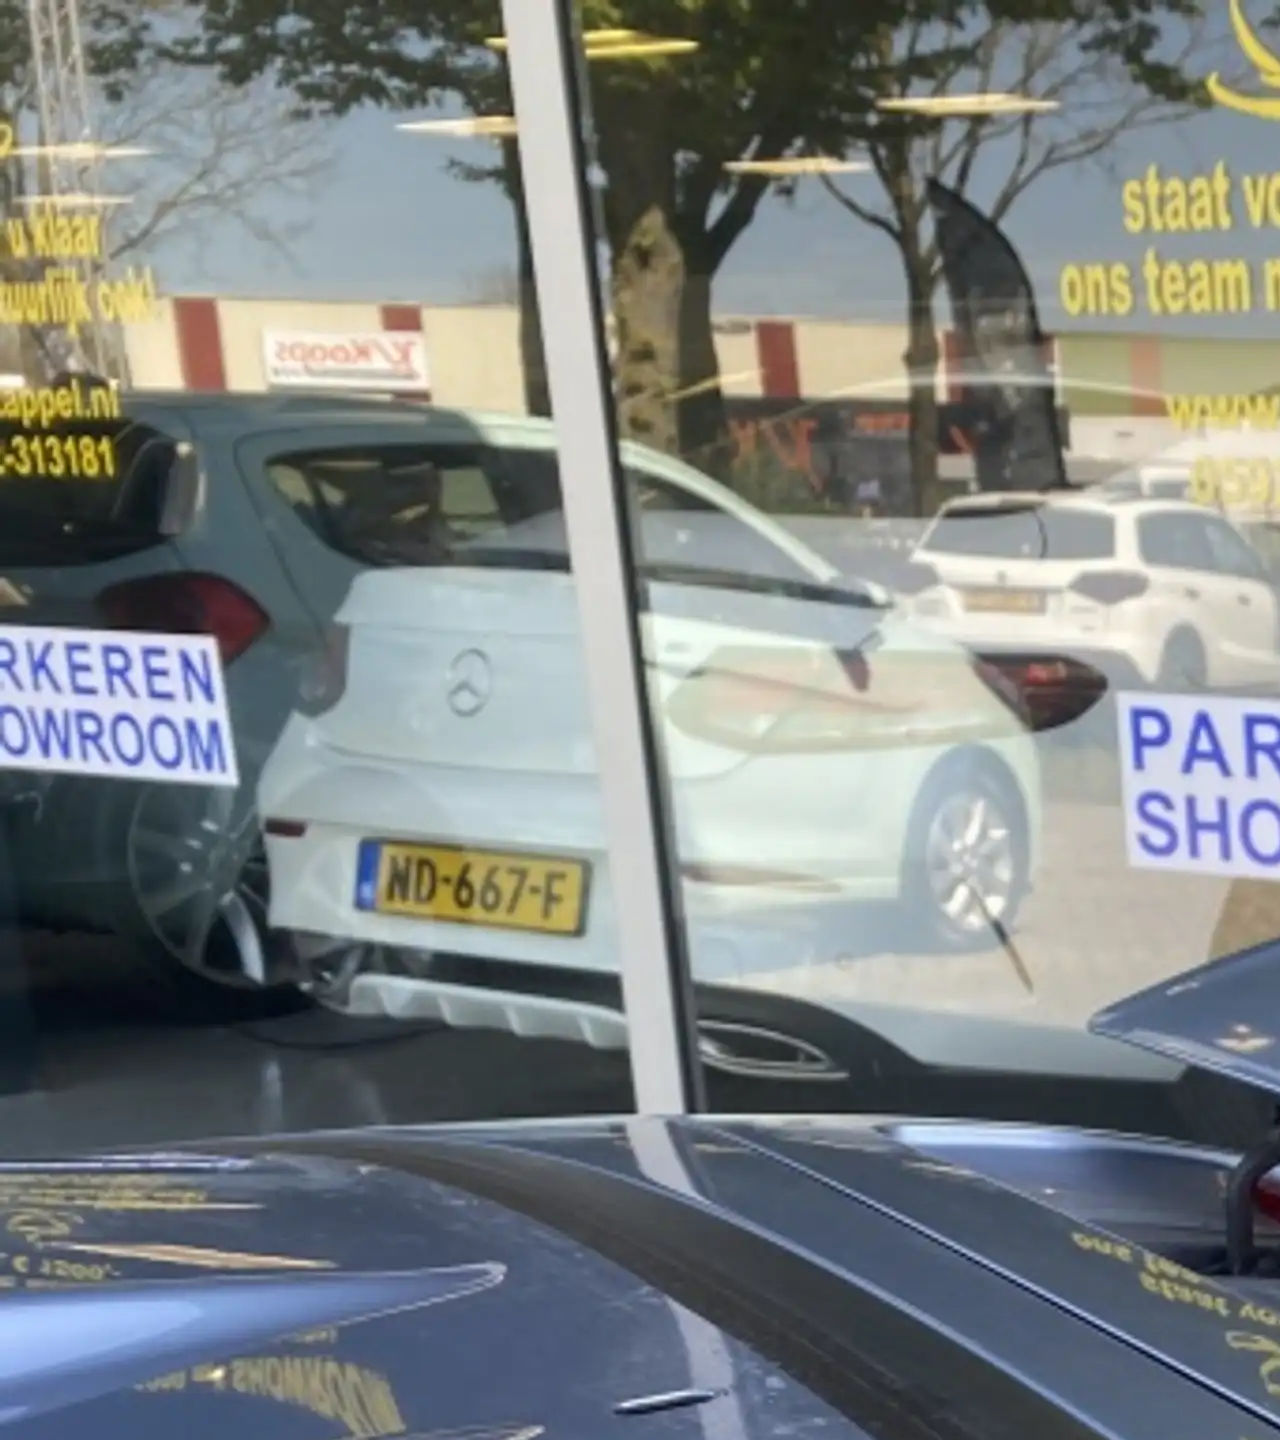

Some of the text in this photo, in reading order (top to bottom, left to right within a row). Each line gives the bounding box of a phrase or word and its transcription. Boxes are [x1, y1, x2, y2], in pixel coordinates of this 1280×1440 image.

[1121, 161, 1232, 234] staat
[7, 203, 101, 260] u klaar
[0, 265, 92, 337] uurlijk
[1060, 262, 1133, 316] ons
[1143, 246, 1251, 314] team
[0, 378, 120, 429] appel.nl
[0, 434, 115, 478] -313181
[386, 855, 568, 921] ND-667-F
